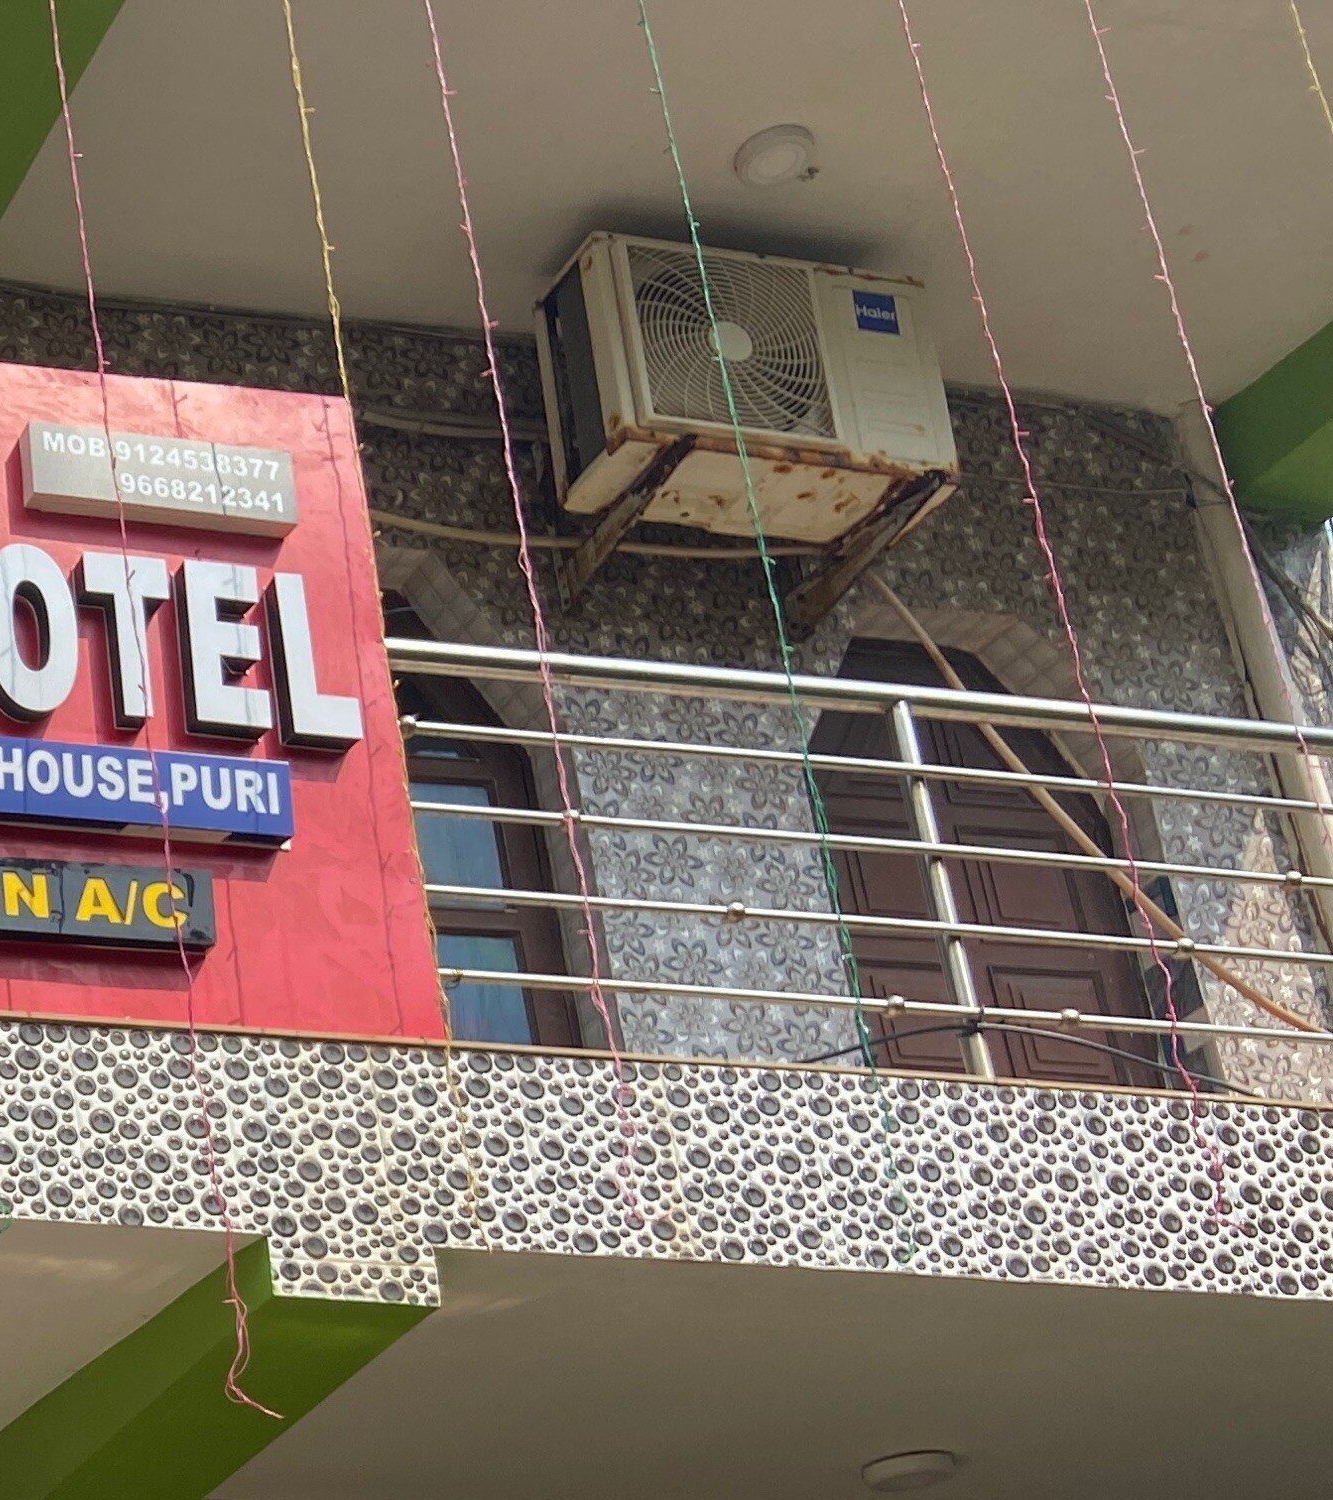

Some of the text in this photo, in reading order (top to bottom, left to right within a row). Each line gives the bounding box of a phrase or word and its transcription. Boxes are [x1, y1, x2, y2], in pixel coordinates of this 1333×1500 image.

[855, 304, 896, 321] Haier
[115, 441, 280, 480] 9124538377
[120, 473, 284, 513] 9668212341
[74, 877, 189, 929] A/C
